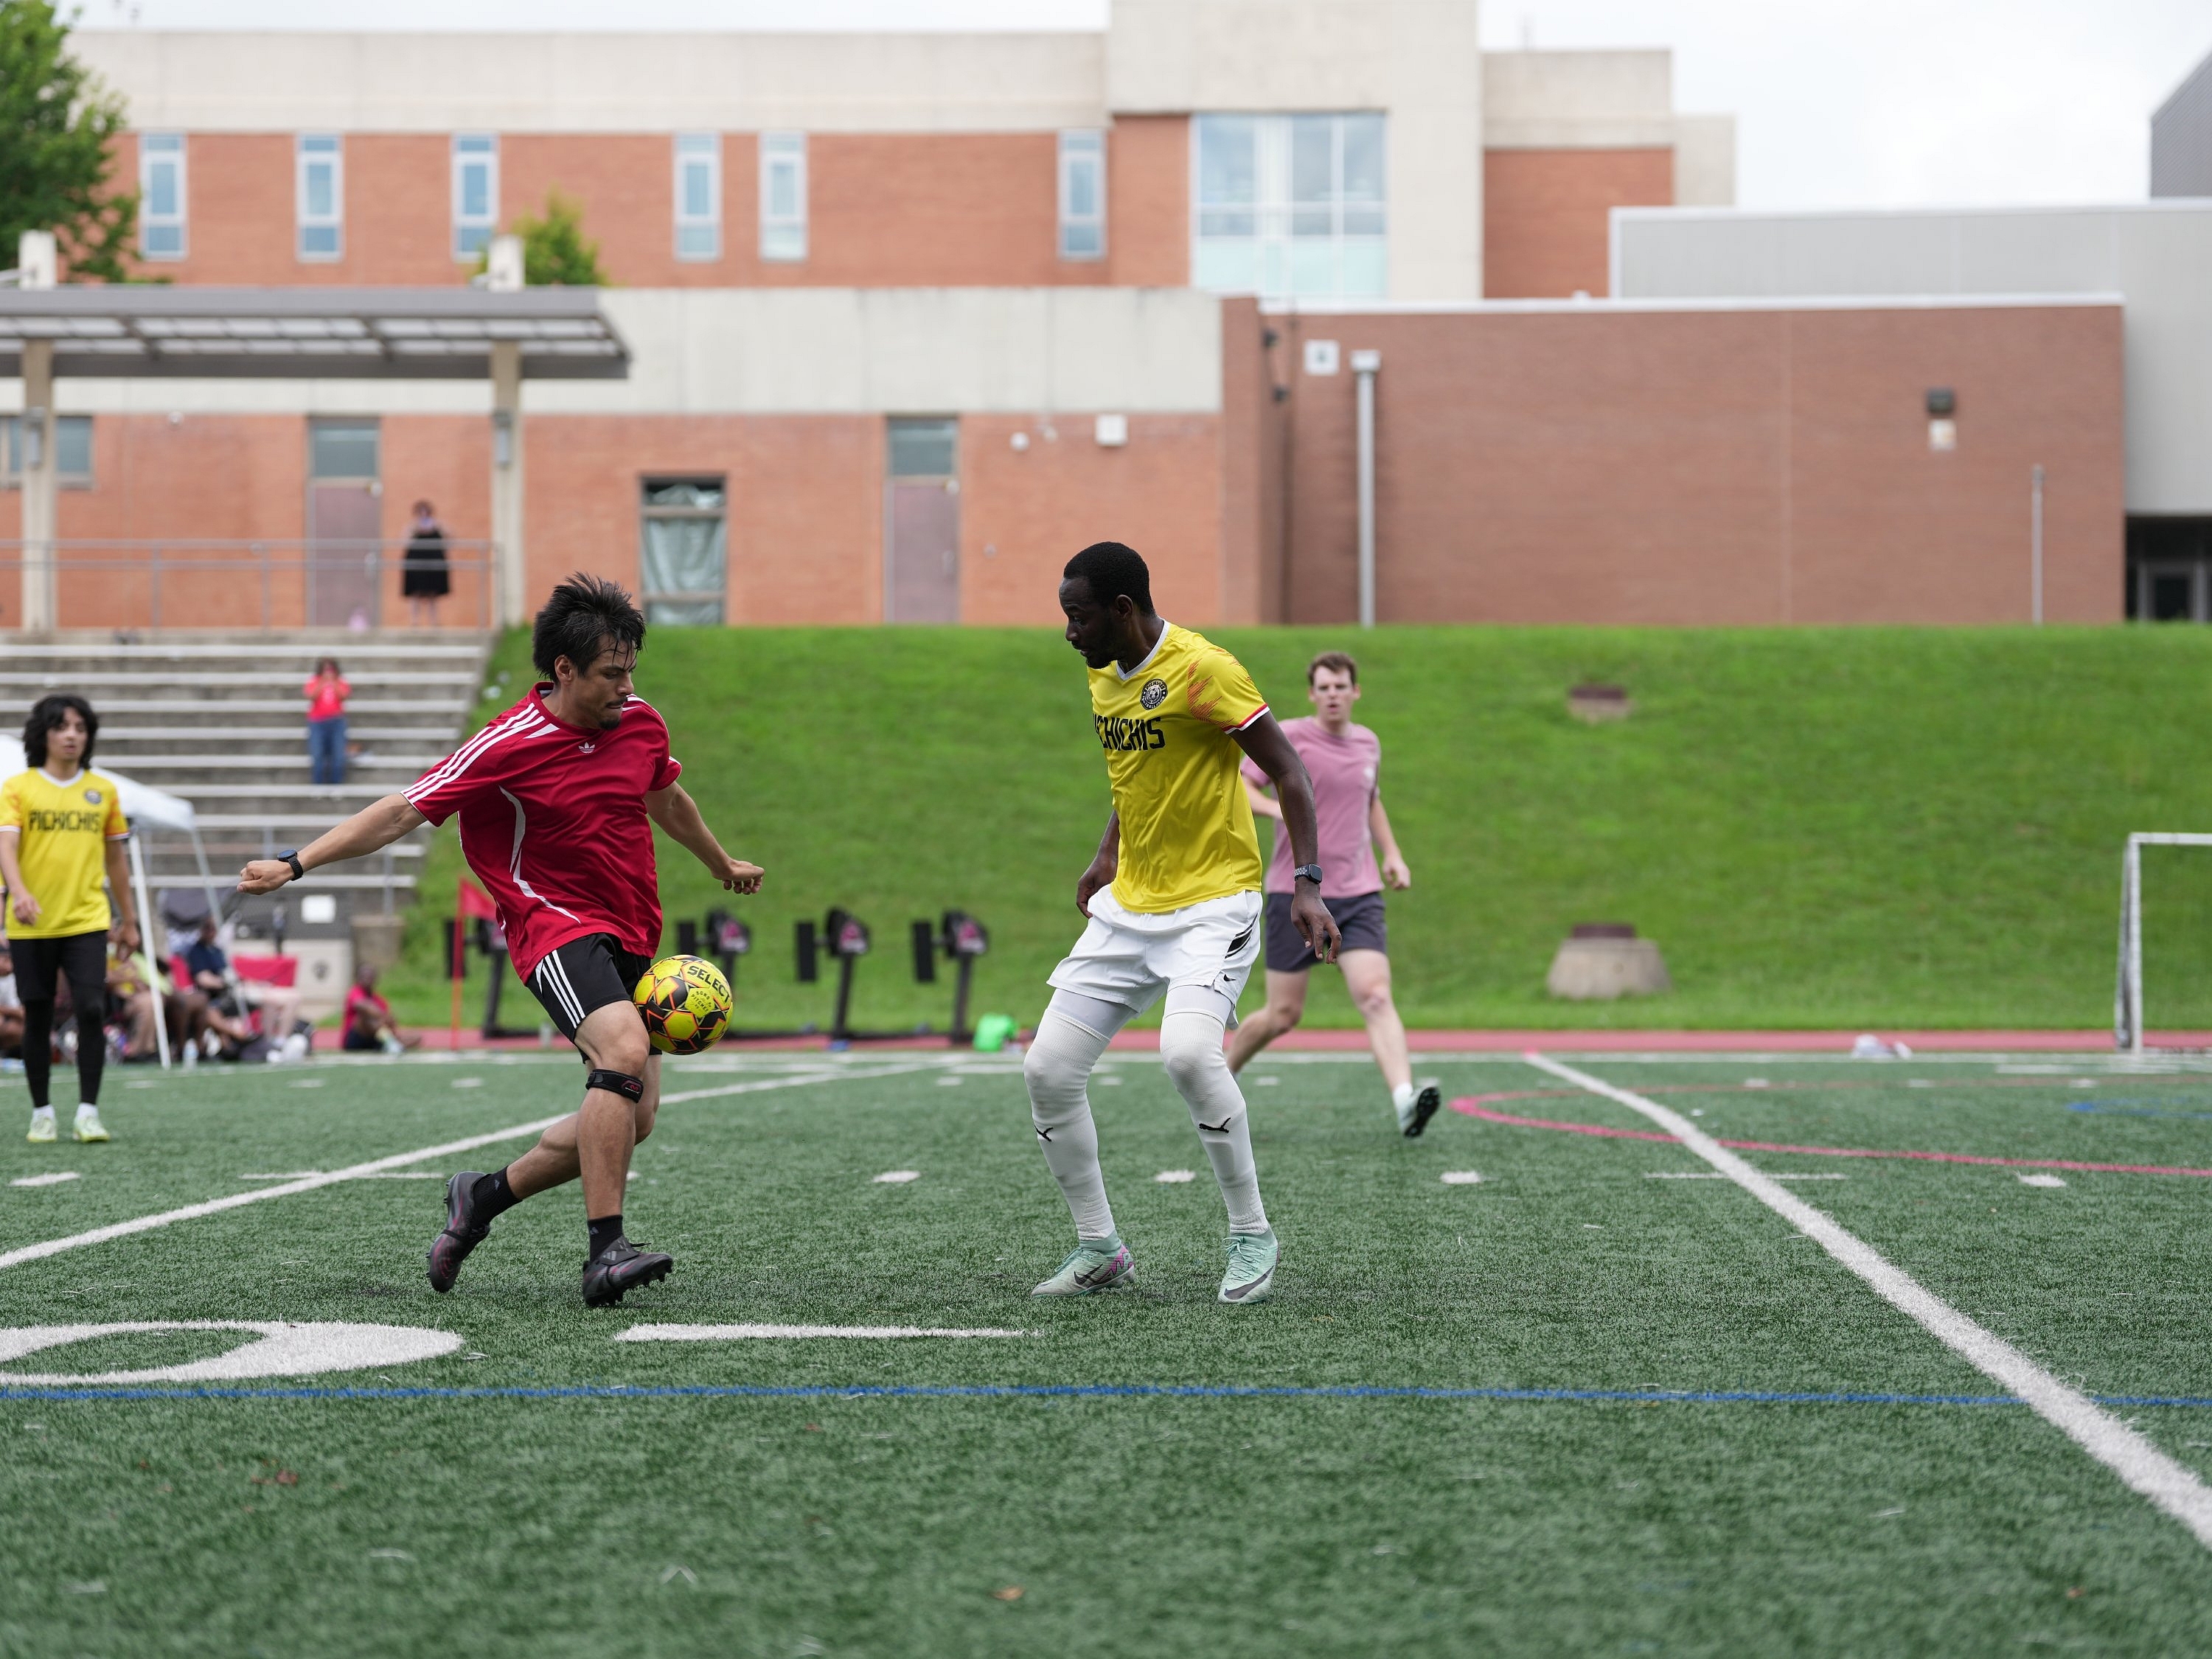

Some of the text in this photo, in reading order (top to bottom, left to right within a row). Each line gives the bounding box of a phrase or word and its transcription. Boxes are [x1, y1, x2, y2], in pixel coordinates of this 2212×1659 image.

[1093, 713, 1165, 751] ICHICHIS
[28, 810, 100, 833] PICHICHIS
[687, 965, 730, 1003] SELECT
